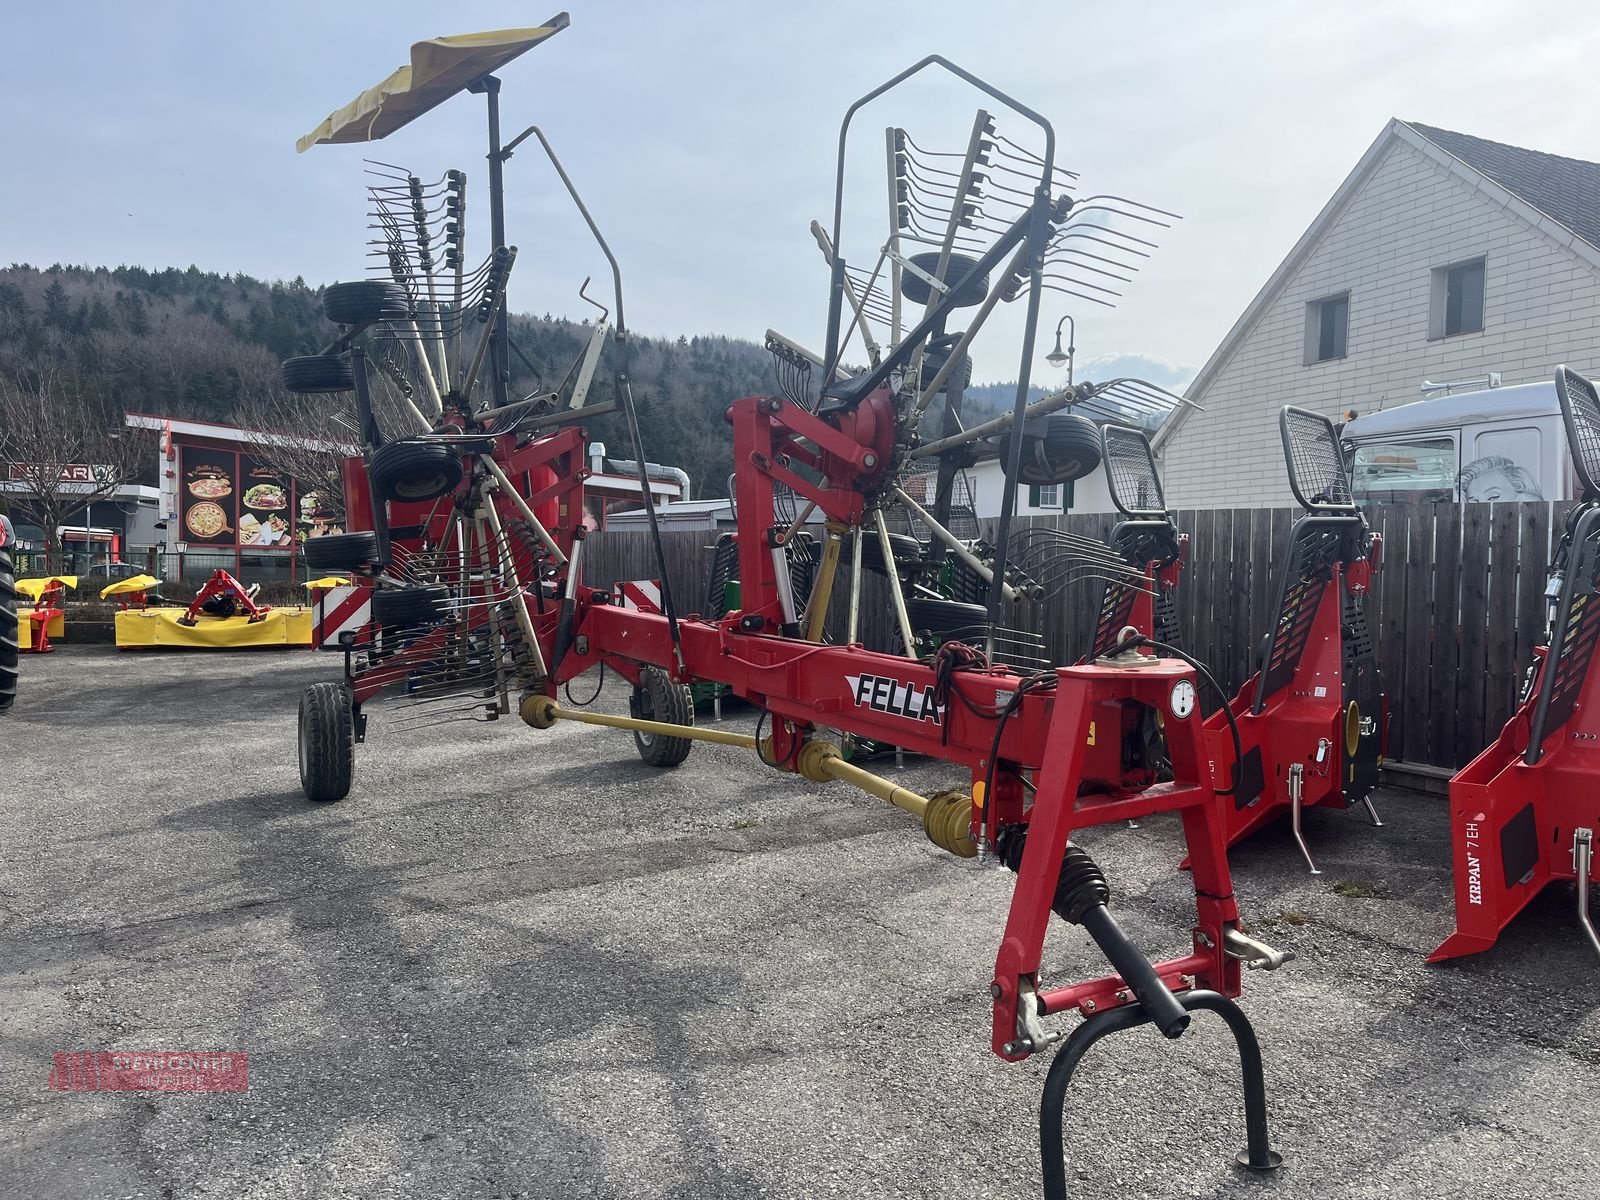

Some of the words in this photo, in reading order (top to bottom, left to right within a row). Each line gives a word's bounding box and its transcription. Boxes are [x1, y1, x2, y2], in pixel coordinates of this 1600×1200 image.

[855, 673, 941, 725] FELLA
[1466, 822, 1479, 839] EH
[1468, 856, 1482, 905] KRPAN
